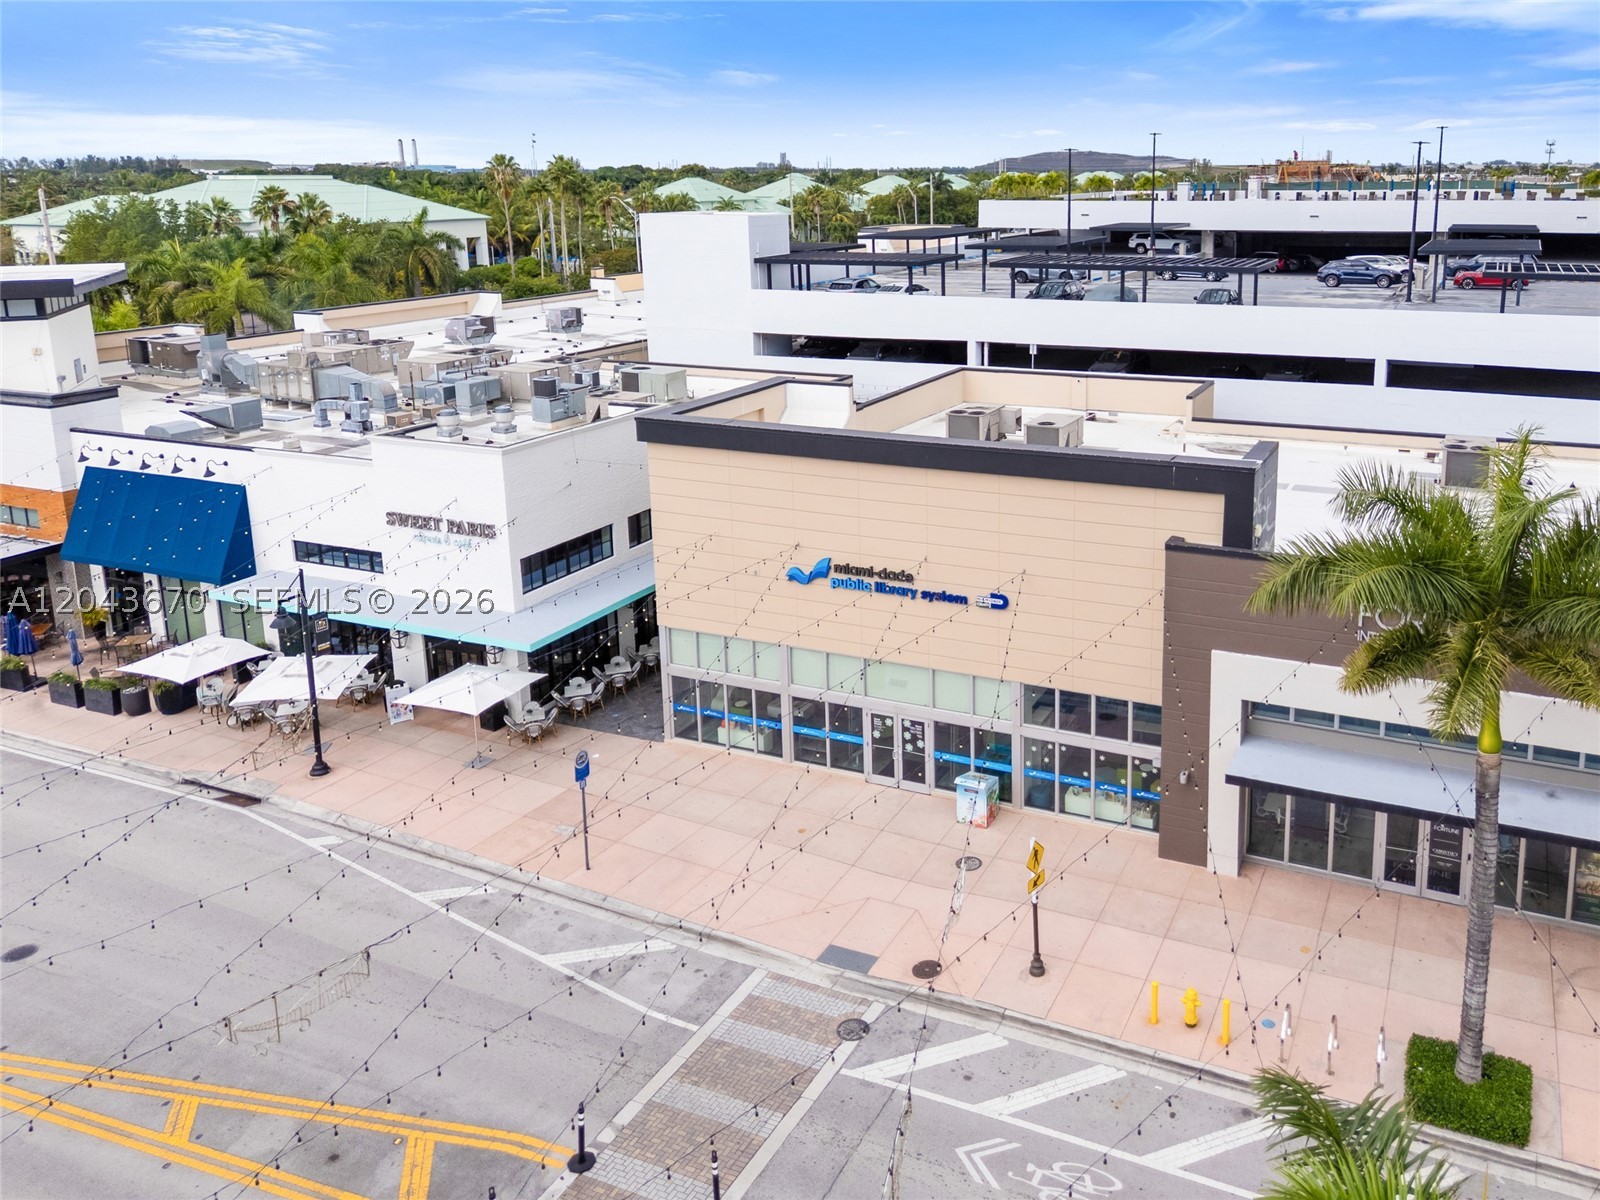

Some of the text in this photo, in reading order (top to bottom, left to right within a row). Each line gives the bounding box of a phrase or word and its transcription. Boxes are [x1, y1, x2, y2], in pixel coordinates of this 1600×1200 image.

[385, 511, 497, 539] SWEET PARIS
[833, 563, 914, 583] miami-dade
[830, 577, 873, 593] public
[874, 582, 918, 600] library
[920, 590, 968, 606] system
